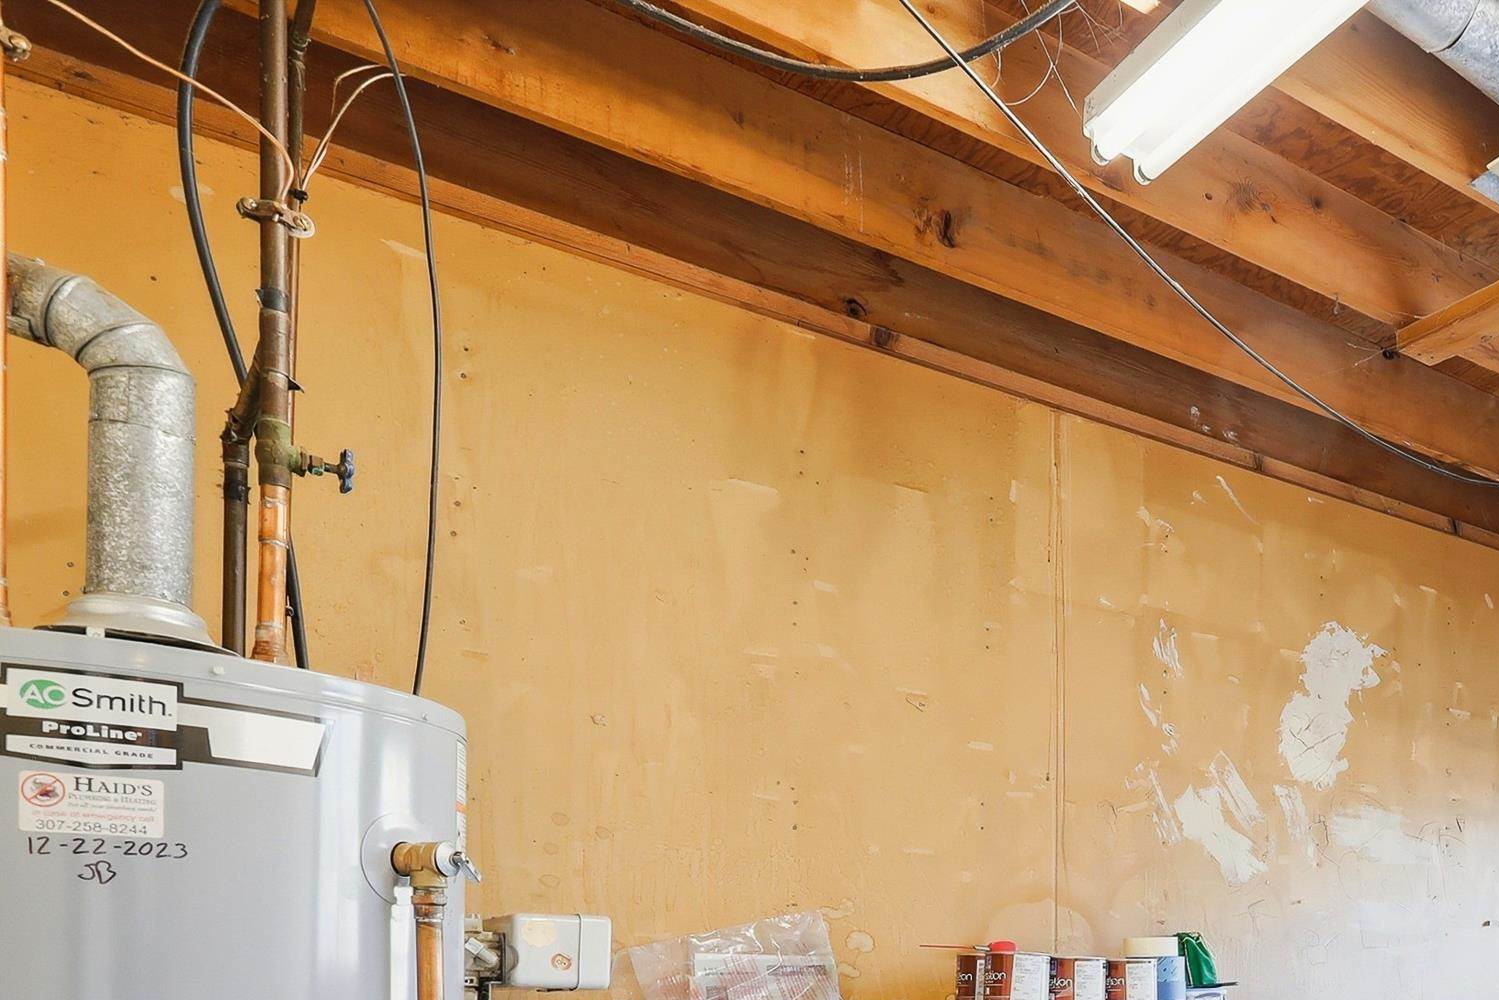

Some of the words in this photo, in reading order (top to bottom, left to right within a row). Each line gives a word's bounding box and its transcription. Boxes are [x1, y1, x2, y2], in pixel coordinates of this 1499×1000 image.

[41, 720, 139, 741] ProLine
[29, 742, 109, 755] COMMERCIAL
[114, 750, 154, 759] GRADE
[73, 776, 153, 796] HAID'S
[35, 819, 148, 835] 307-258-8244
